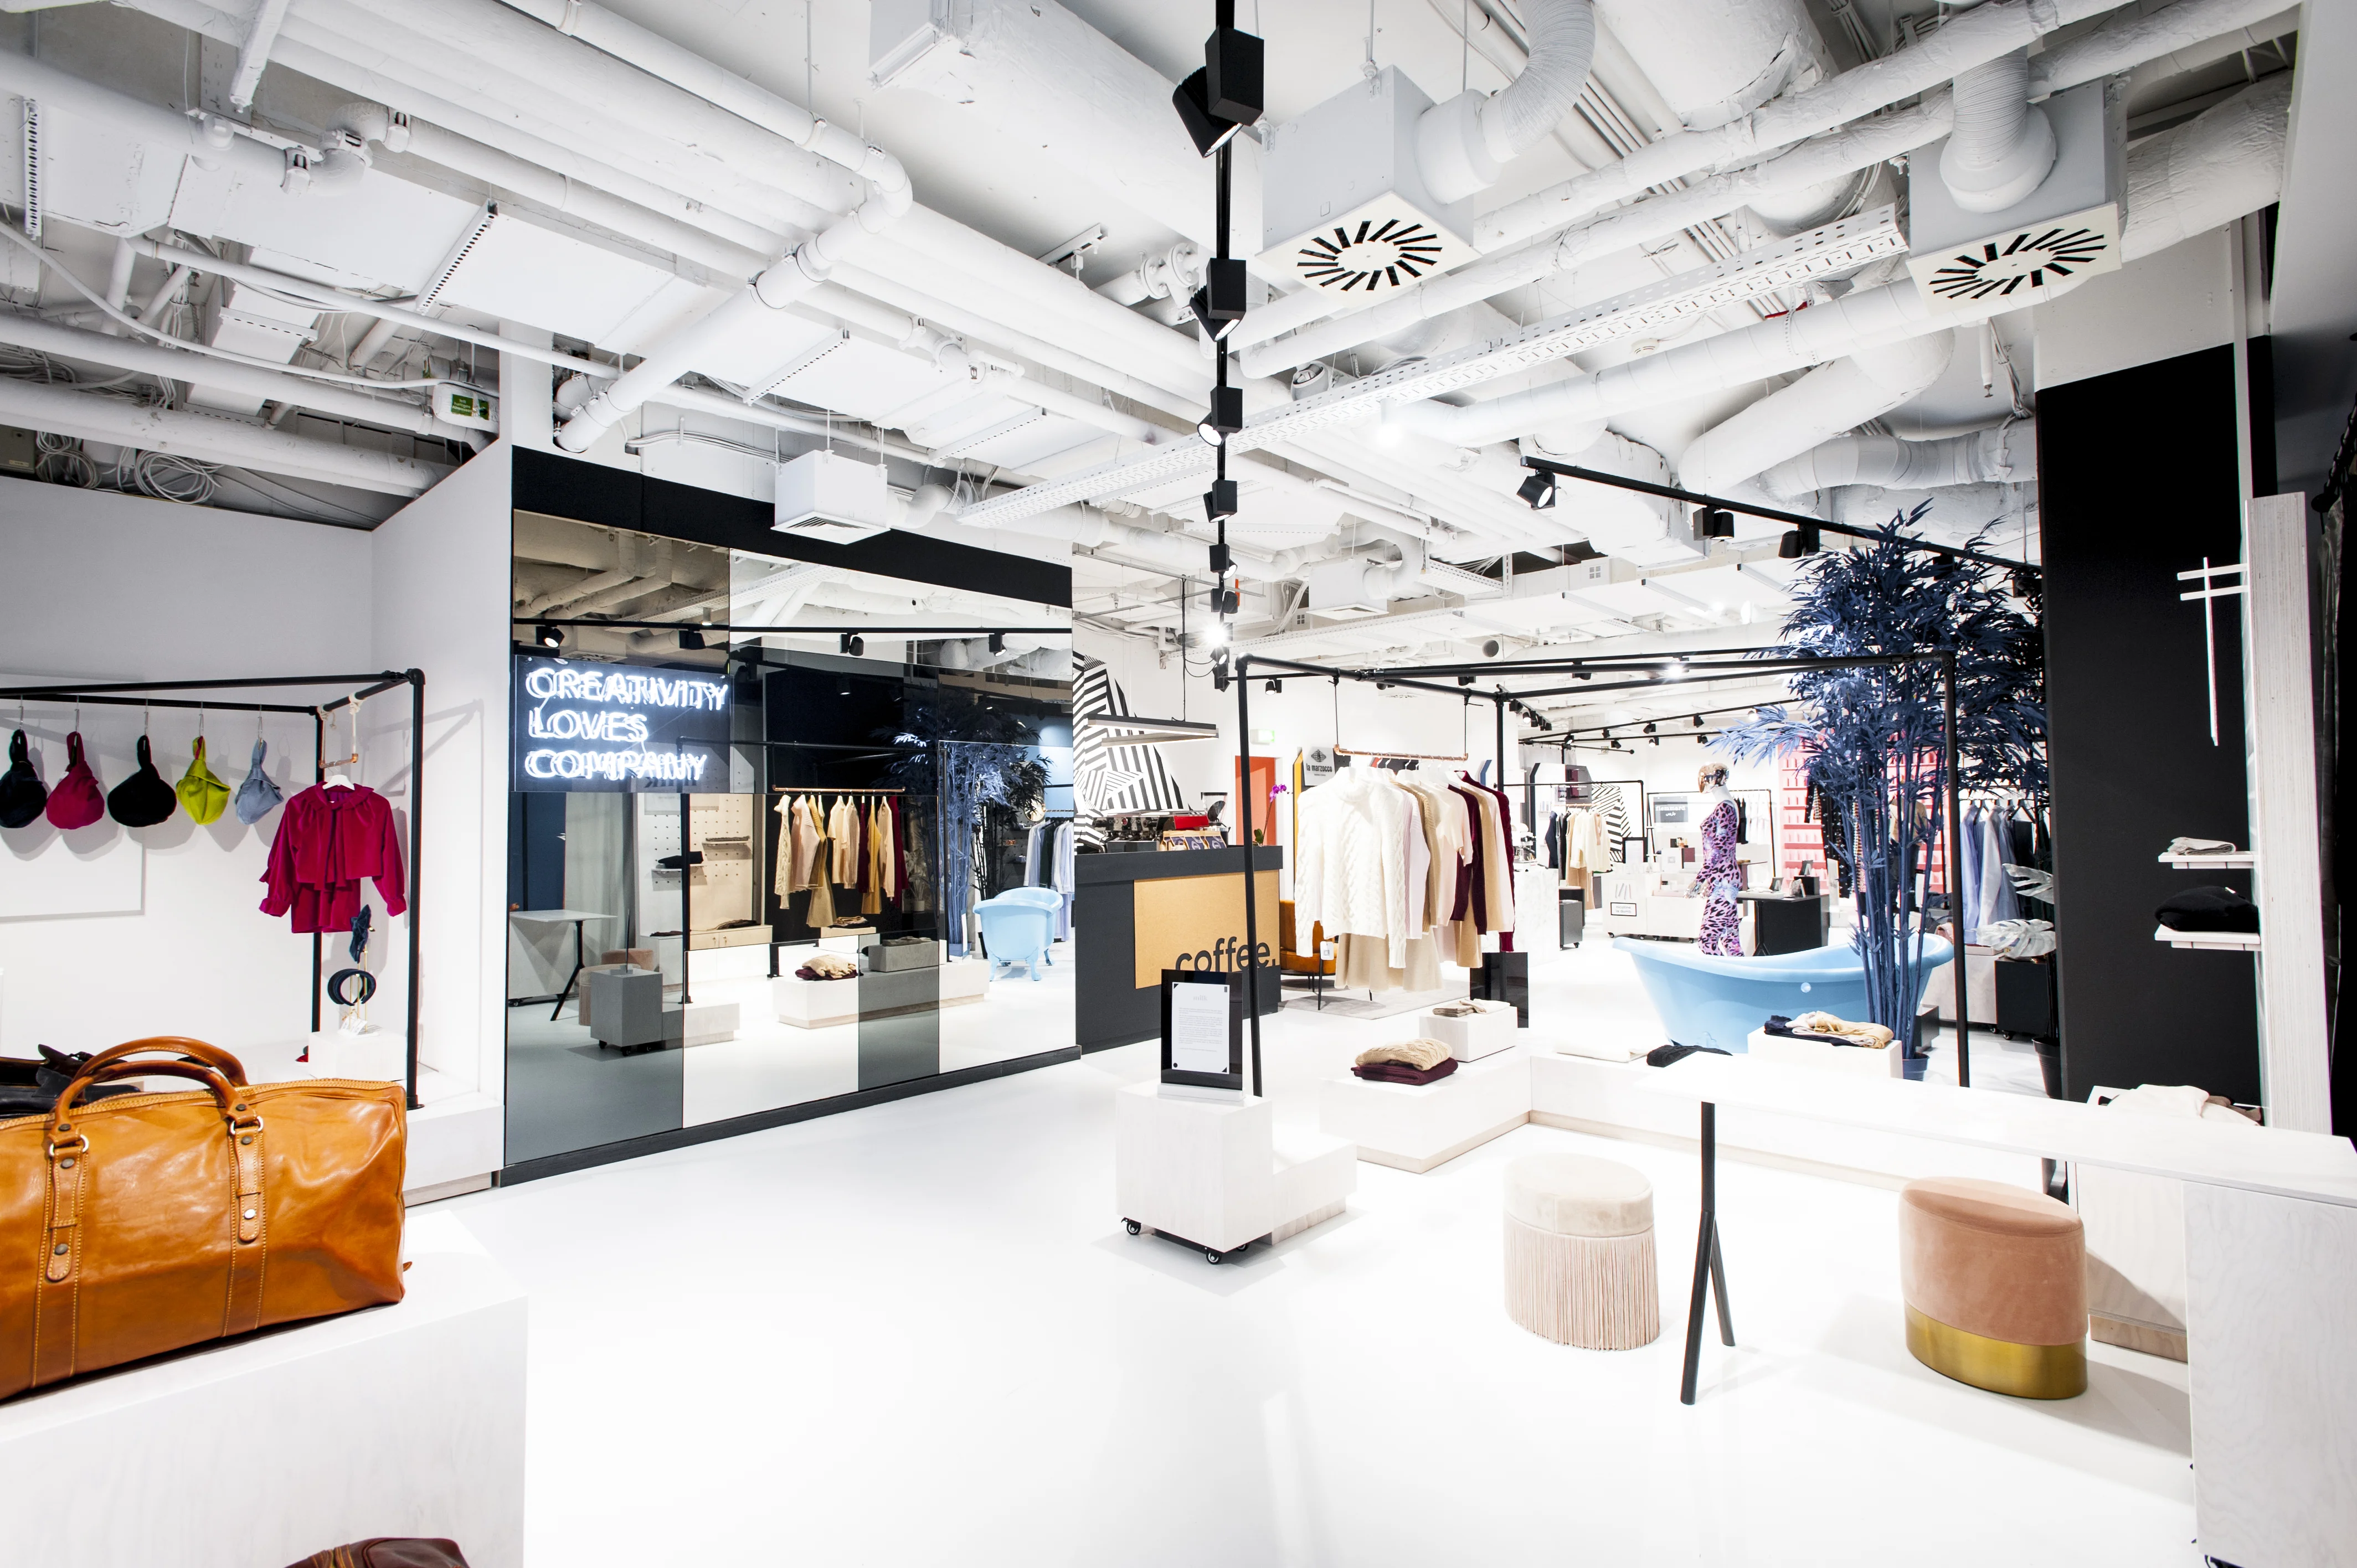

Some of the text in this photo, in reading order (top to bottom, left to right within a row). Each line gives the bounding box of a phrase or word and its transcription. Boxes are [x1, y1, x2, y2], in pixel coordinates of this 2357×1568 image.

[526, 668, 728, 710] CREATIVITY
[529, 707, 649, 742] LOVES
[525, 749, 707, 781] COMPANY
[1306, 762, 1310, 771] la
